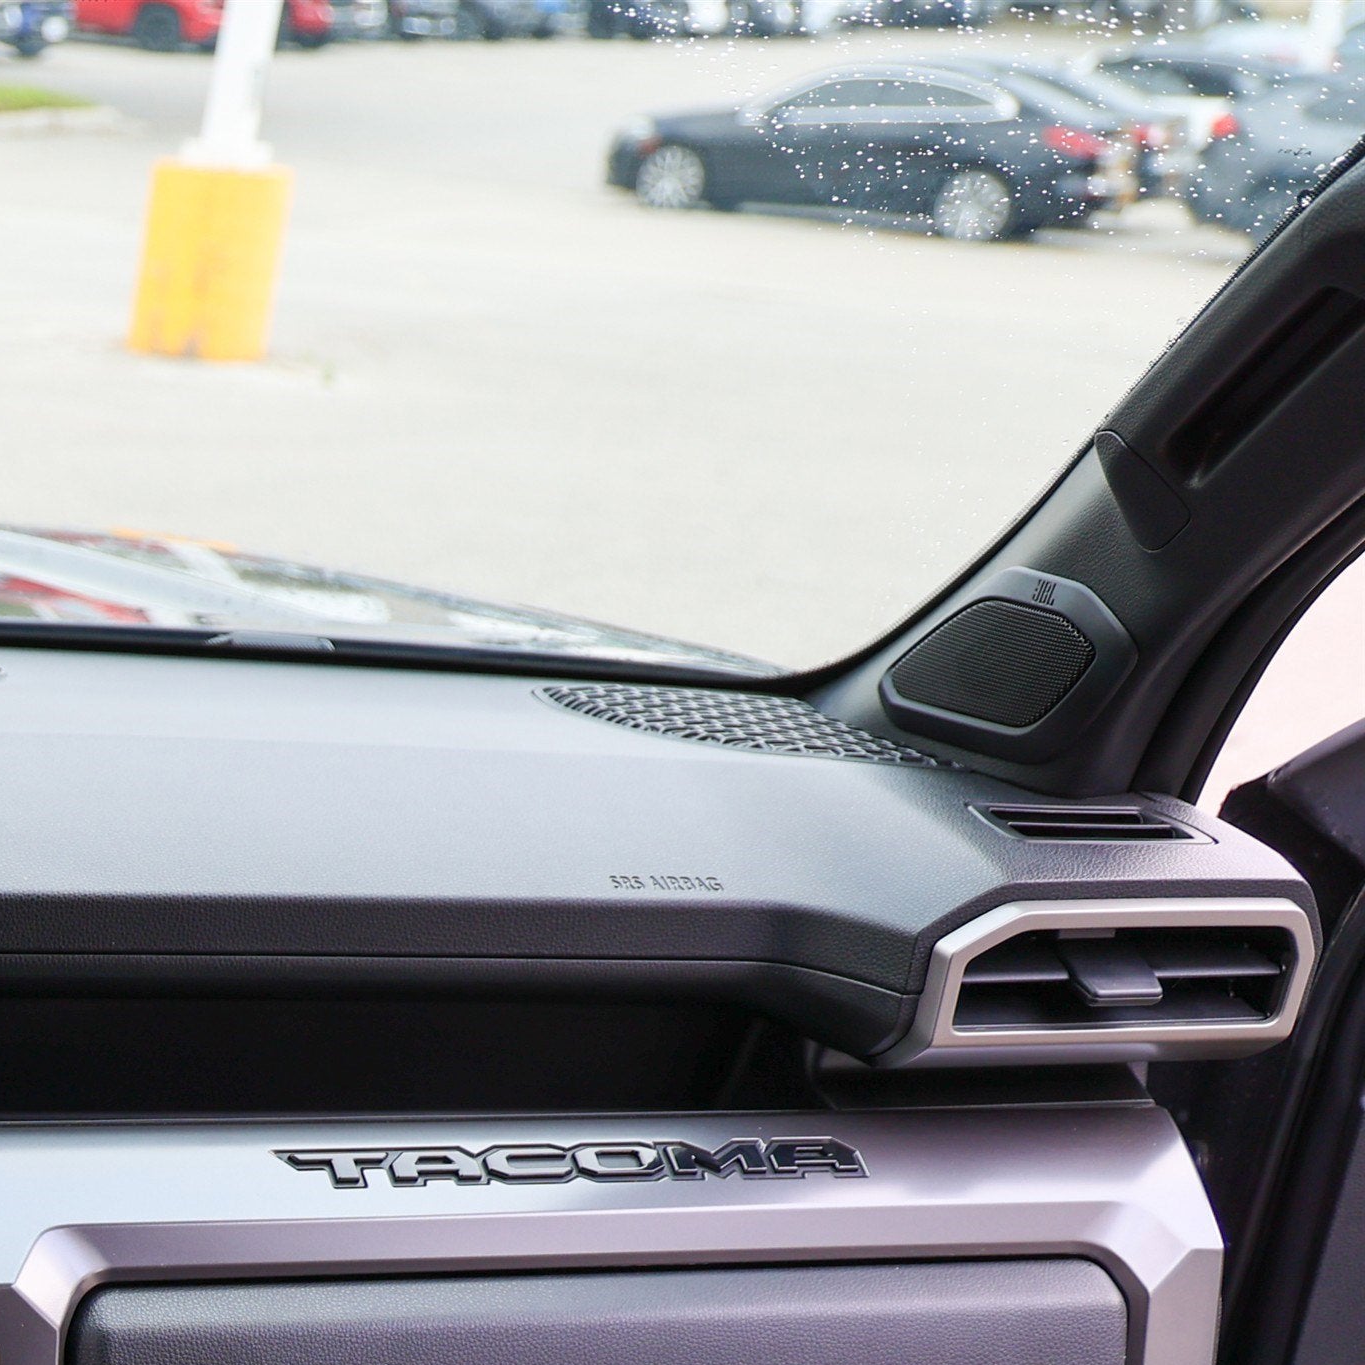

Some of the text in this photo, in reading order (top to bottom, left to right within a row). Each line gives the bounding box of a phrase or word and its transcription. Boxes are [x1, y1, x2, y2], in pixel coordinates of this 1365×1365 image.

[1032, 579, 1057, 606] JBL
[609, 875, 724, 891] SRS AIRBAG
[269, 1137, 870, 1189] TACOMA
